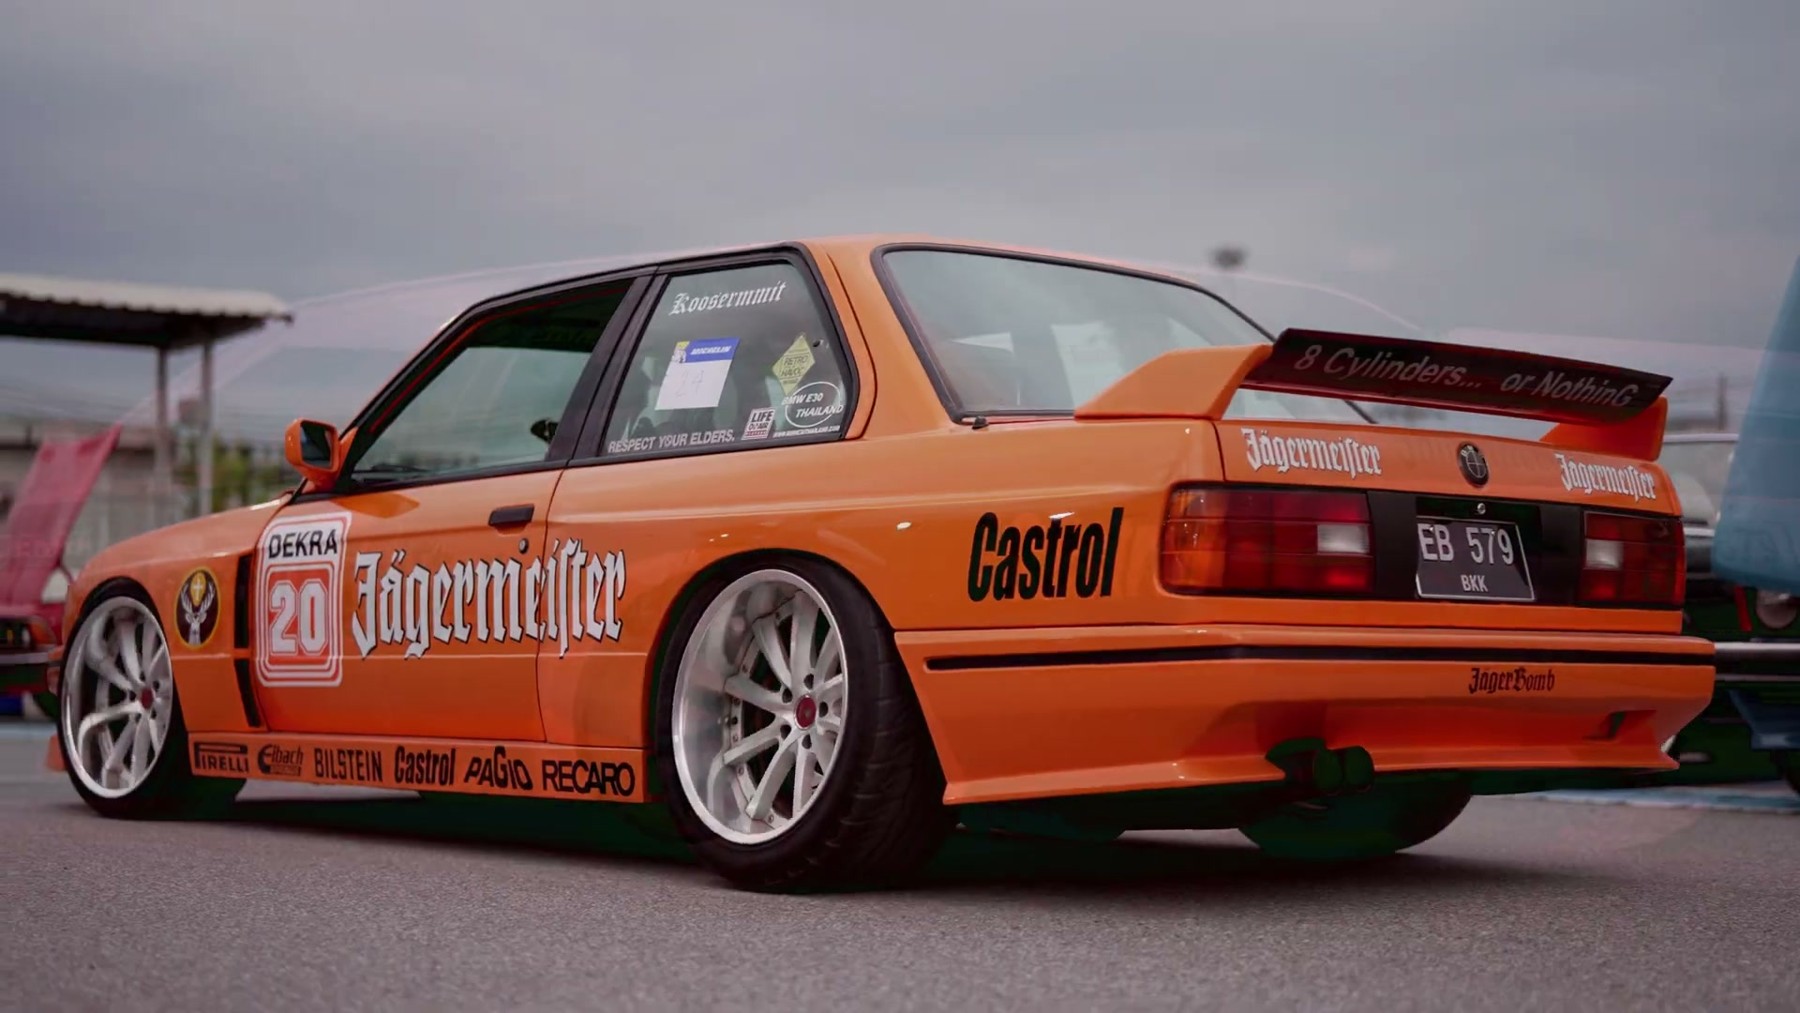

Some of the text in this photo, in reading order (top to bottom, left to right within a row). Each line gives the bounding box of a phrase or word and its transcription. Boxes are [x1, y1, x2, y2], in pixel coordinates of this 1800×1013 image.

[1294, 344, 1322, 370] 8
[1324, 348, 1482, 388] Cylinders...
[1500, 373, 1536, 393] or
[796, 405, 844, 418] THAILAND
[806, 393, 823, 404] E30
[752, 410, 773, 423] LIFE
[608, 437, 656, 453] RESPECT
[690, 429, 735, 445] ELDERS.
[1241, 427, 1382, 480] Jägermeister
[268, 529, 338, 559] DEKRA
[968, 507, 1124, 602] Castrol
[1418, 523, 1514, 565] EB 579
[352, 538, 626, 660] Jägermeister
[1460, 574, 1489, 592] BKK
[270, 579, 328, 656] 20
[194, 742, 249, 773] PIRELLI
[257, 744, 304, 774] Eibach
[314, 748, 383, 782] BILSTEIN
[394, 745, 456, 786] Castrol
[542, 759, 636, 797] RECARO
